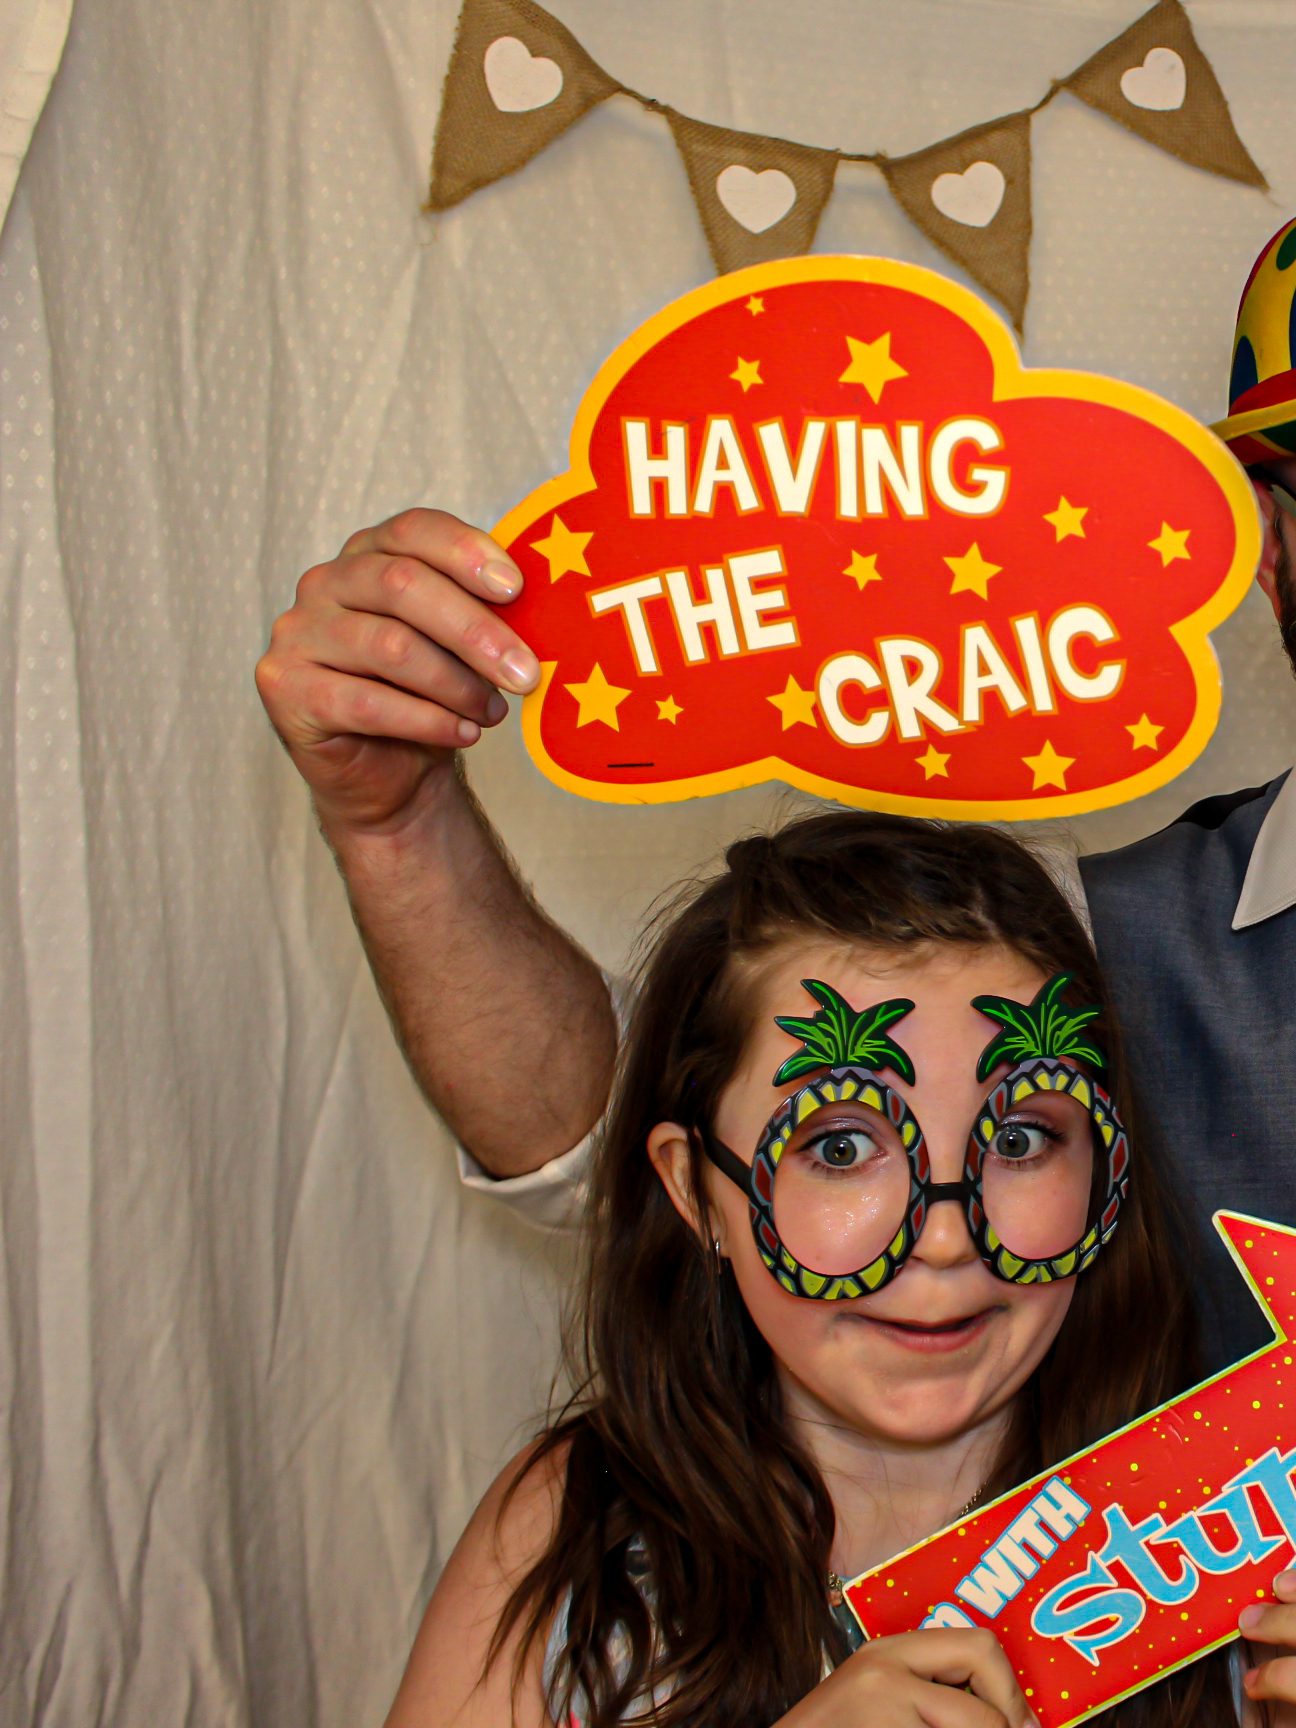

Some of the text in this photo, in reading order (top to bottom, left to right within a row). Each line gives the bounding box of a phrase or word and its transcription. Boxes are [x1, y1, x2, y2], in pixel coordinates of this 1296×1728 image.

[623, 417, 1009, 520] HAVING
[589, 548, 798, 675] THE
[816, 605, 1124, 747] CRAIC
[954, 1475, 1092, 1619] WITH
